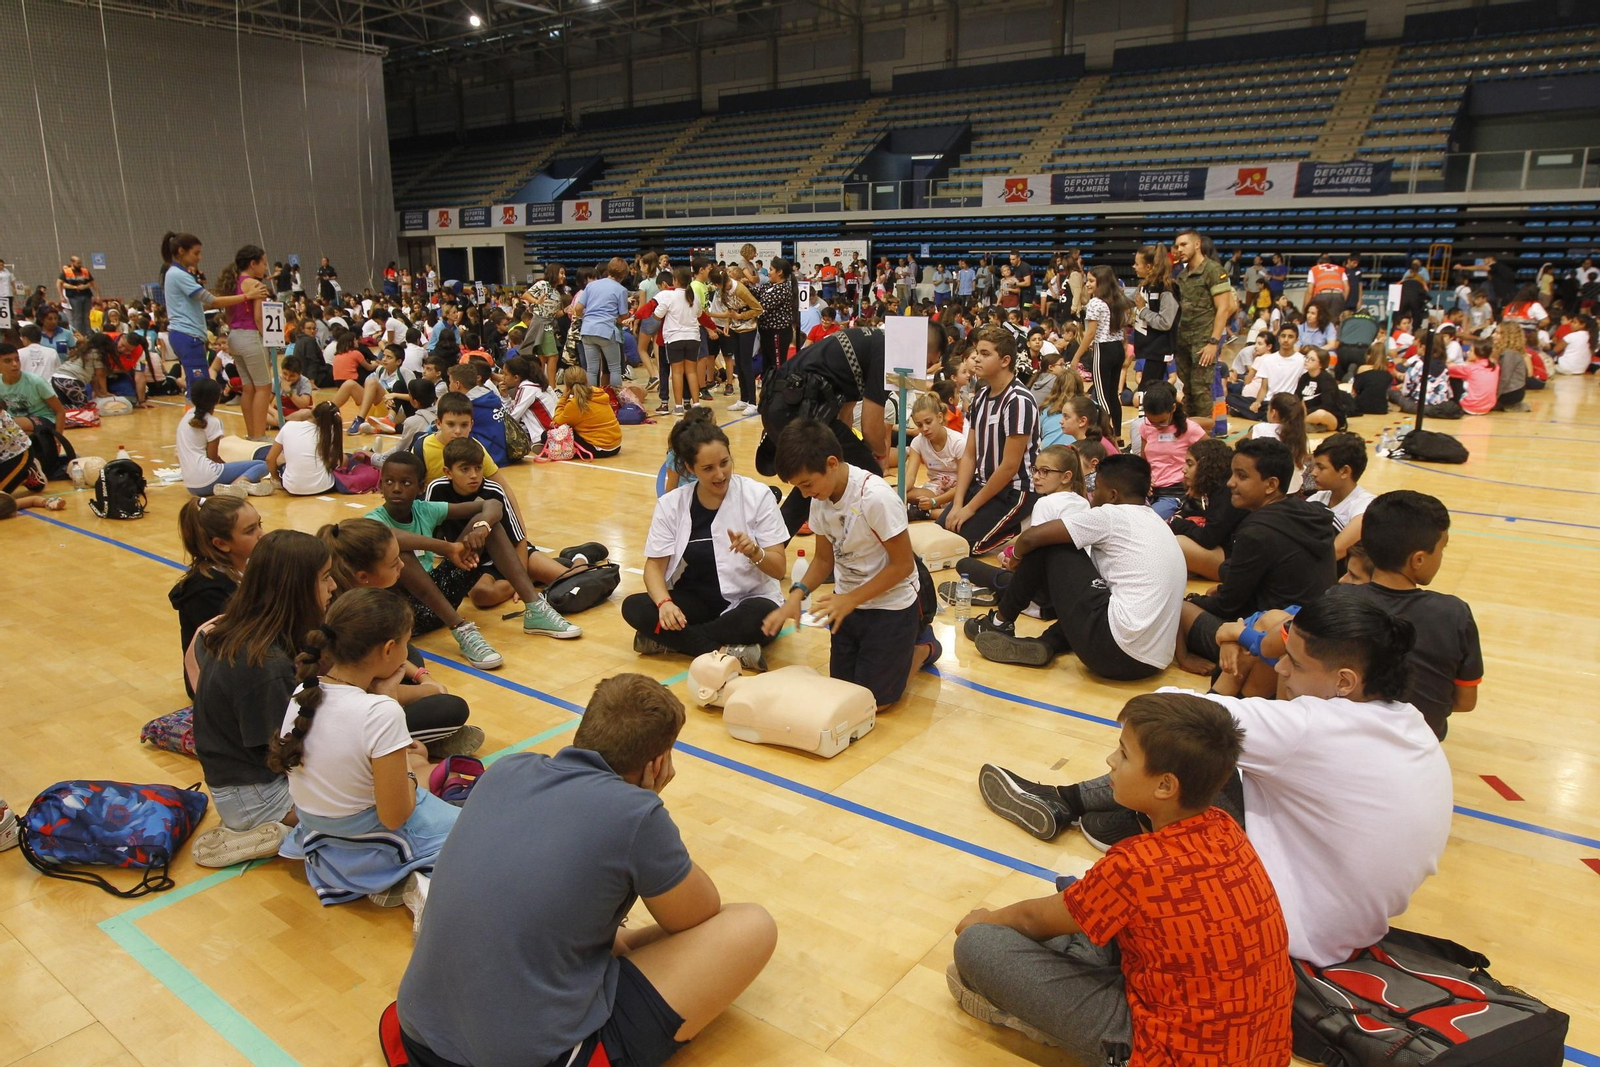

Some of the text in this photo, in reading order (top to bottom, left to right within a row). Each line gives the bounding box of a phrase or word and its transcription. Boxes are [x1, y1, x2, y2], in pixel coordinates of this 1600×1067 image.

[1314, 167, 1373, 176] DEPORTES
[1064, 178, 1110, 186] DEPORTES
[1313, 176, 1371, 185] DE ALMERIA
[266, 315, 282, 332] 21
